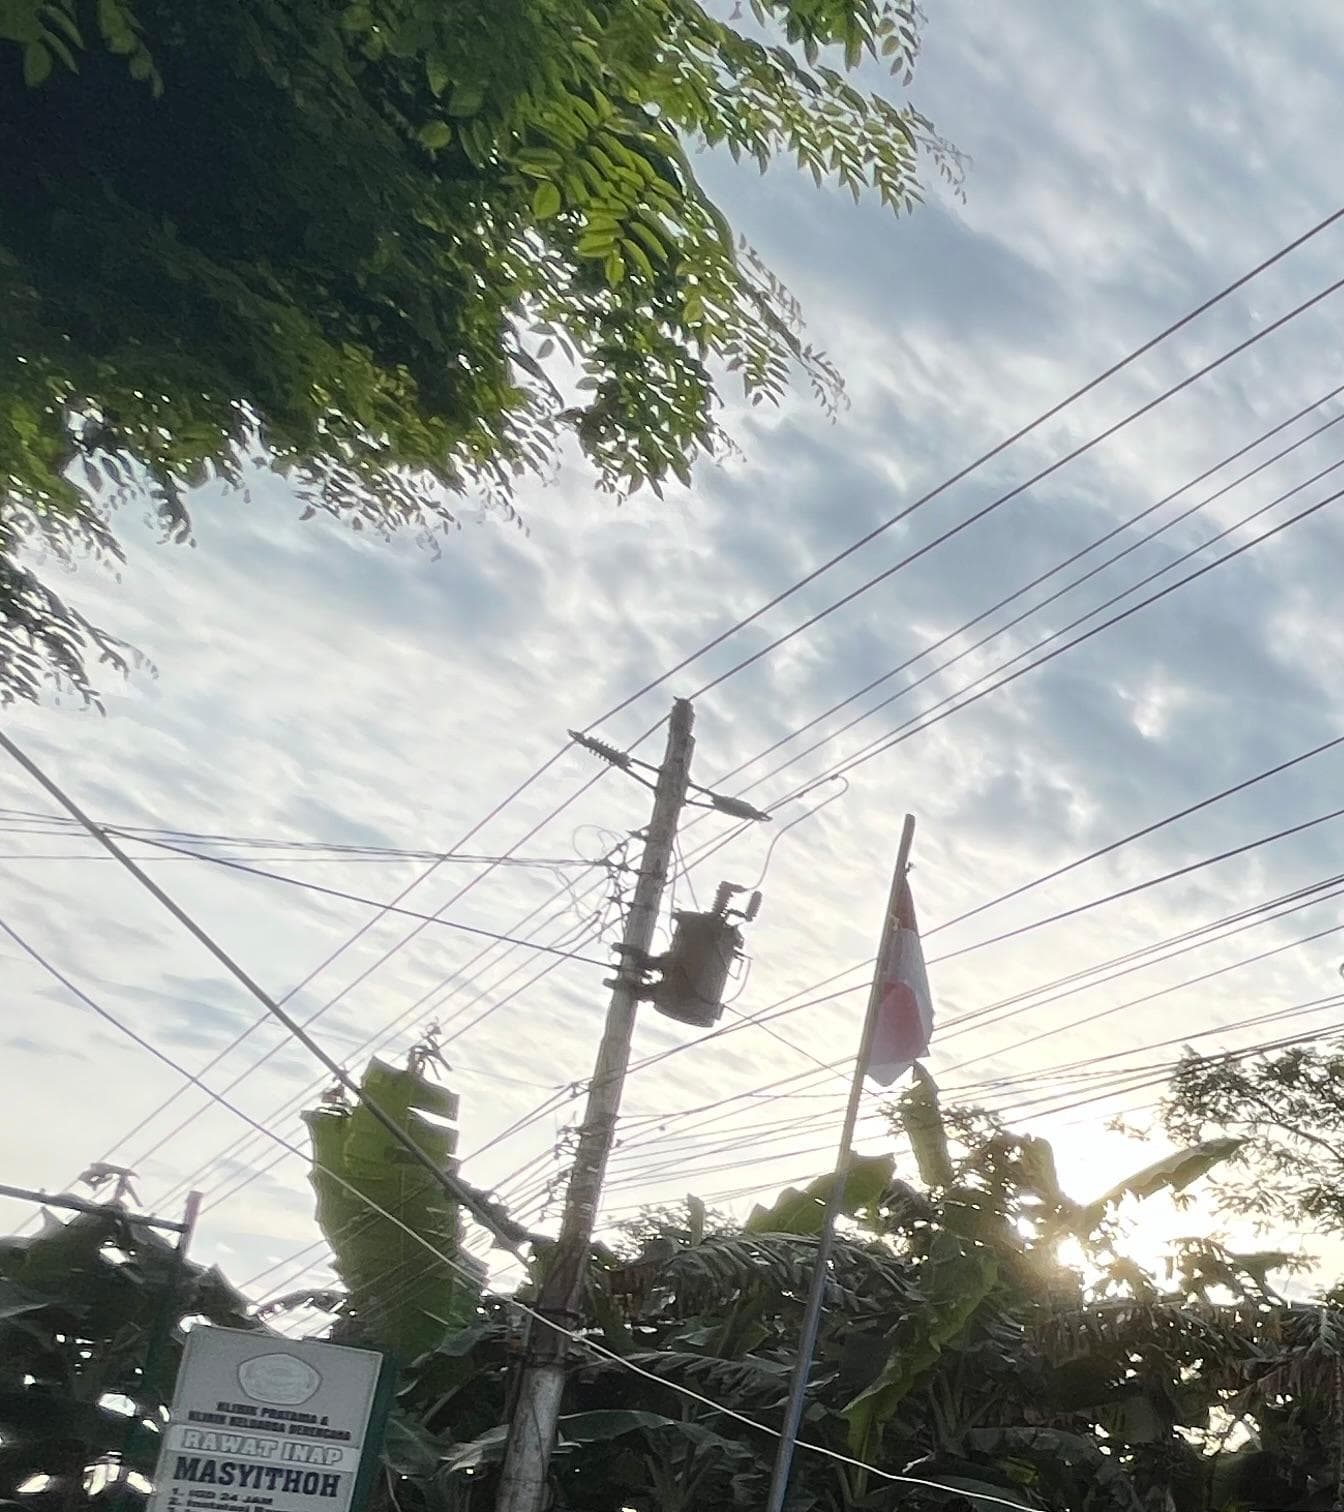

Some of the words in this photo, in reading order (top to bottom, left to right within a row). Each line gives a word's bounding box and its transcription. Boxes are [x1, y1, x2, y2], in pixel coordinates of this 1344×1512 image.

[184, 1429, 278, 1457] RAWAT
[281, 1441, 343, 1465] INAP
[173, 1456, 341, 1497] MASYITHOH
